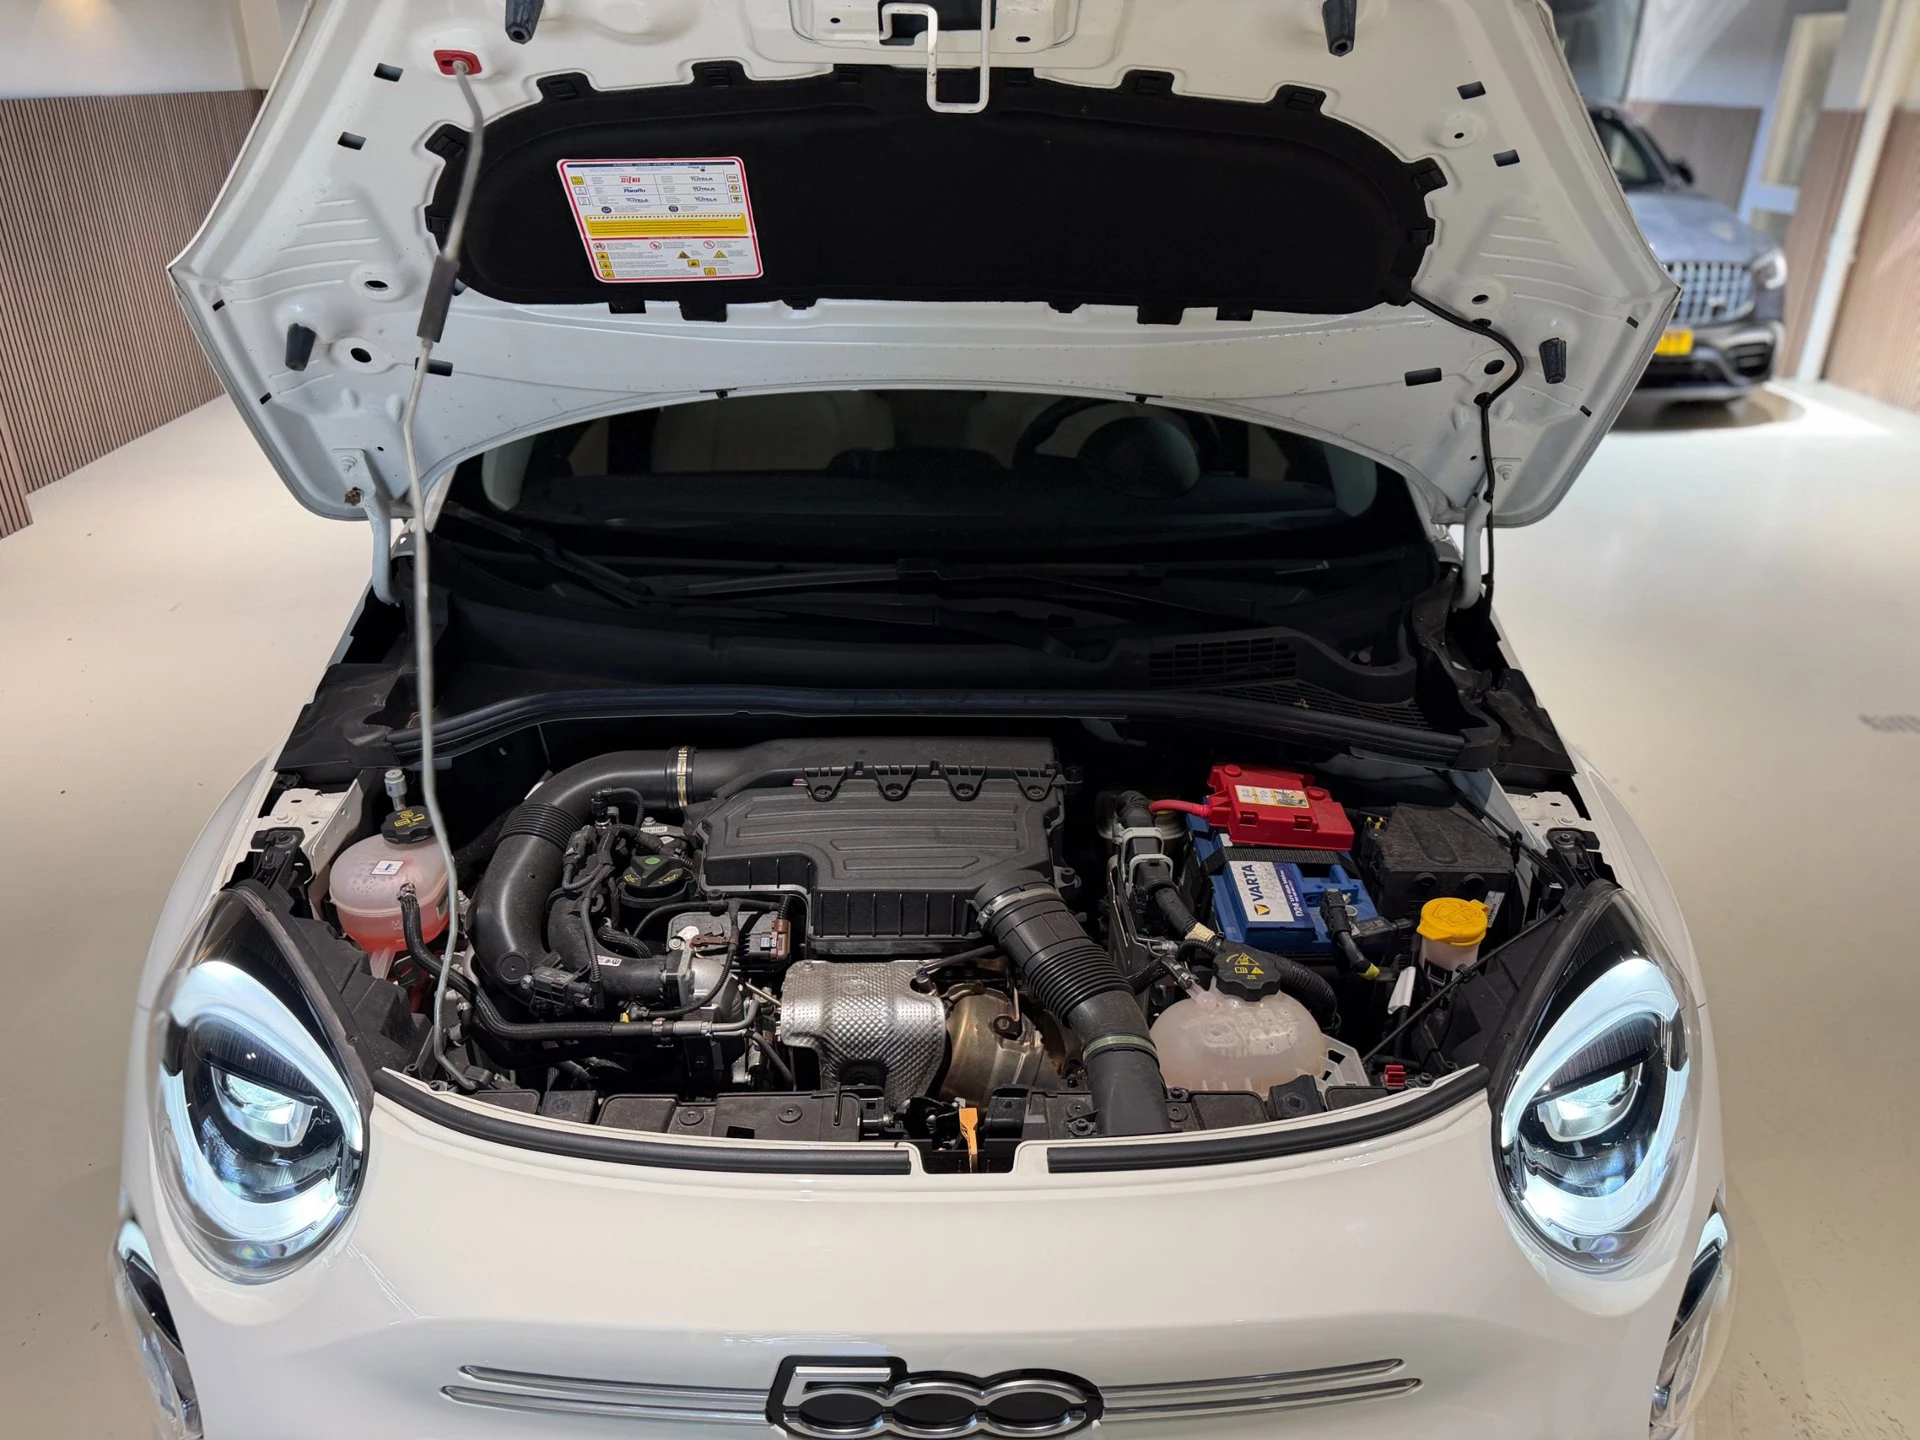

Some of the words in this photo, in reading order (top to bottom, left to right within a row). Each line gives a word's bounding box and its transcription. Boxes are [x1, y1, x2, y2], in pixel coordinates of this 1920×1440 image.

[1242, 864, 1264, 901] VARTA
[1292, 902, 1304, 917] D24
[776, 1361, 1094, 1440] 500
